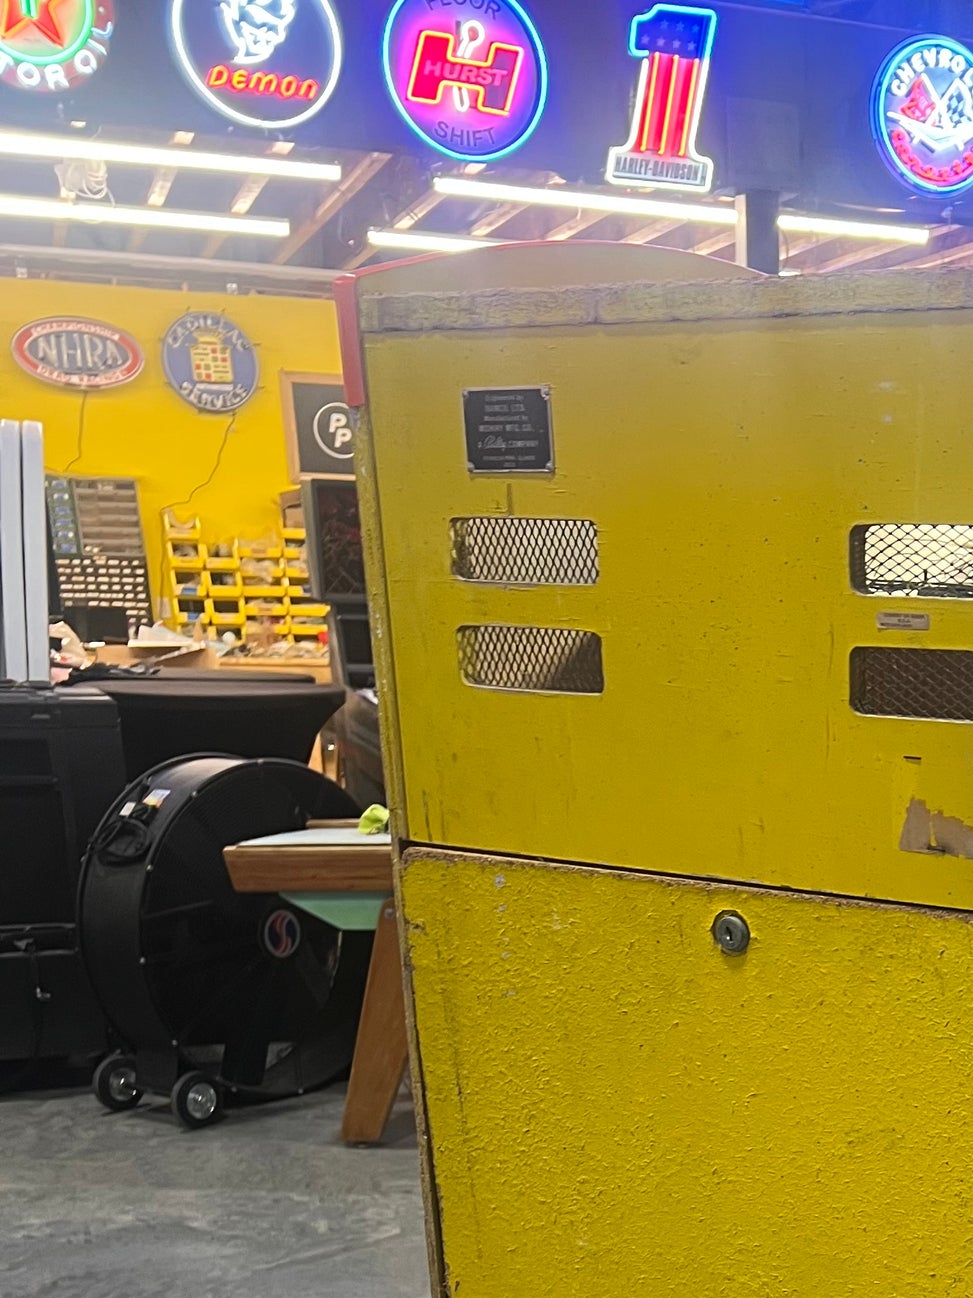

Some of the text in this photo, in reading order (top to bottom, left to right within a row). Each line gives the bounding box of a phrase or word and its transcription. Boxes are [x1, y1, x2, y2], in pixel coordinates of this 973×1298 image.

[73, 21, 114, 75] OIL
[423, 60, 509, 86] HURST
[434, 121, 496, 147] SHIFT
[615, 155, 701, 181] HARLEY-DAVIDSON
[167, 314, 250, 353] CADILLAC
[36, 332, 123, 370] NHRA
[178, 381, 249, 411] SERVICE
